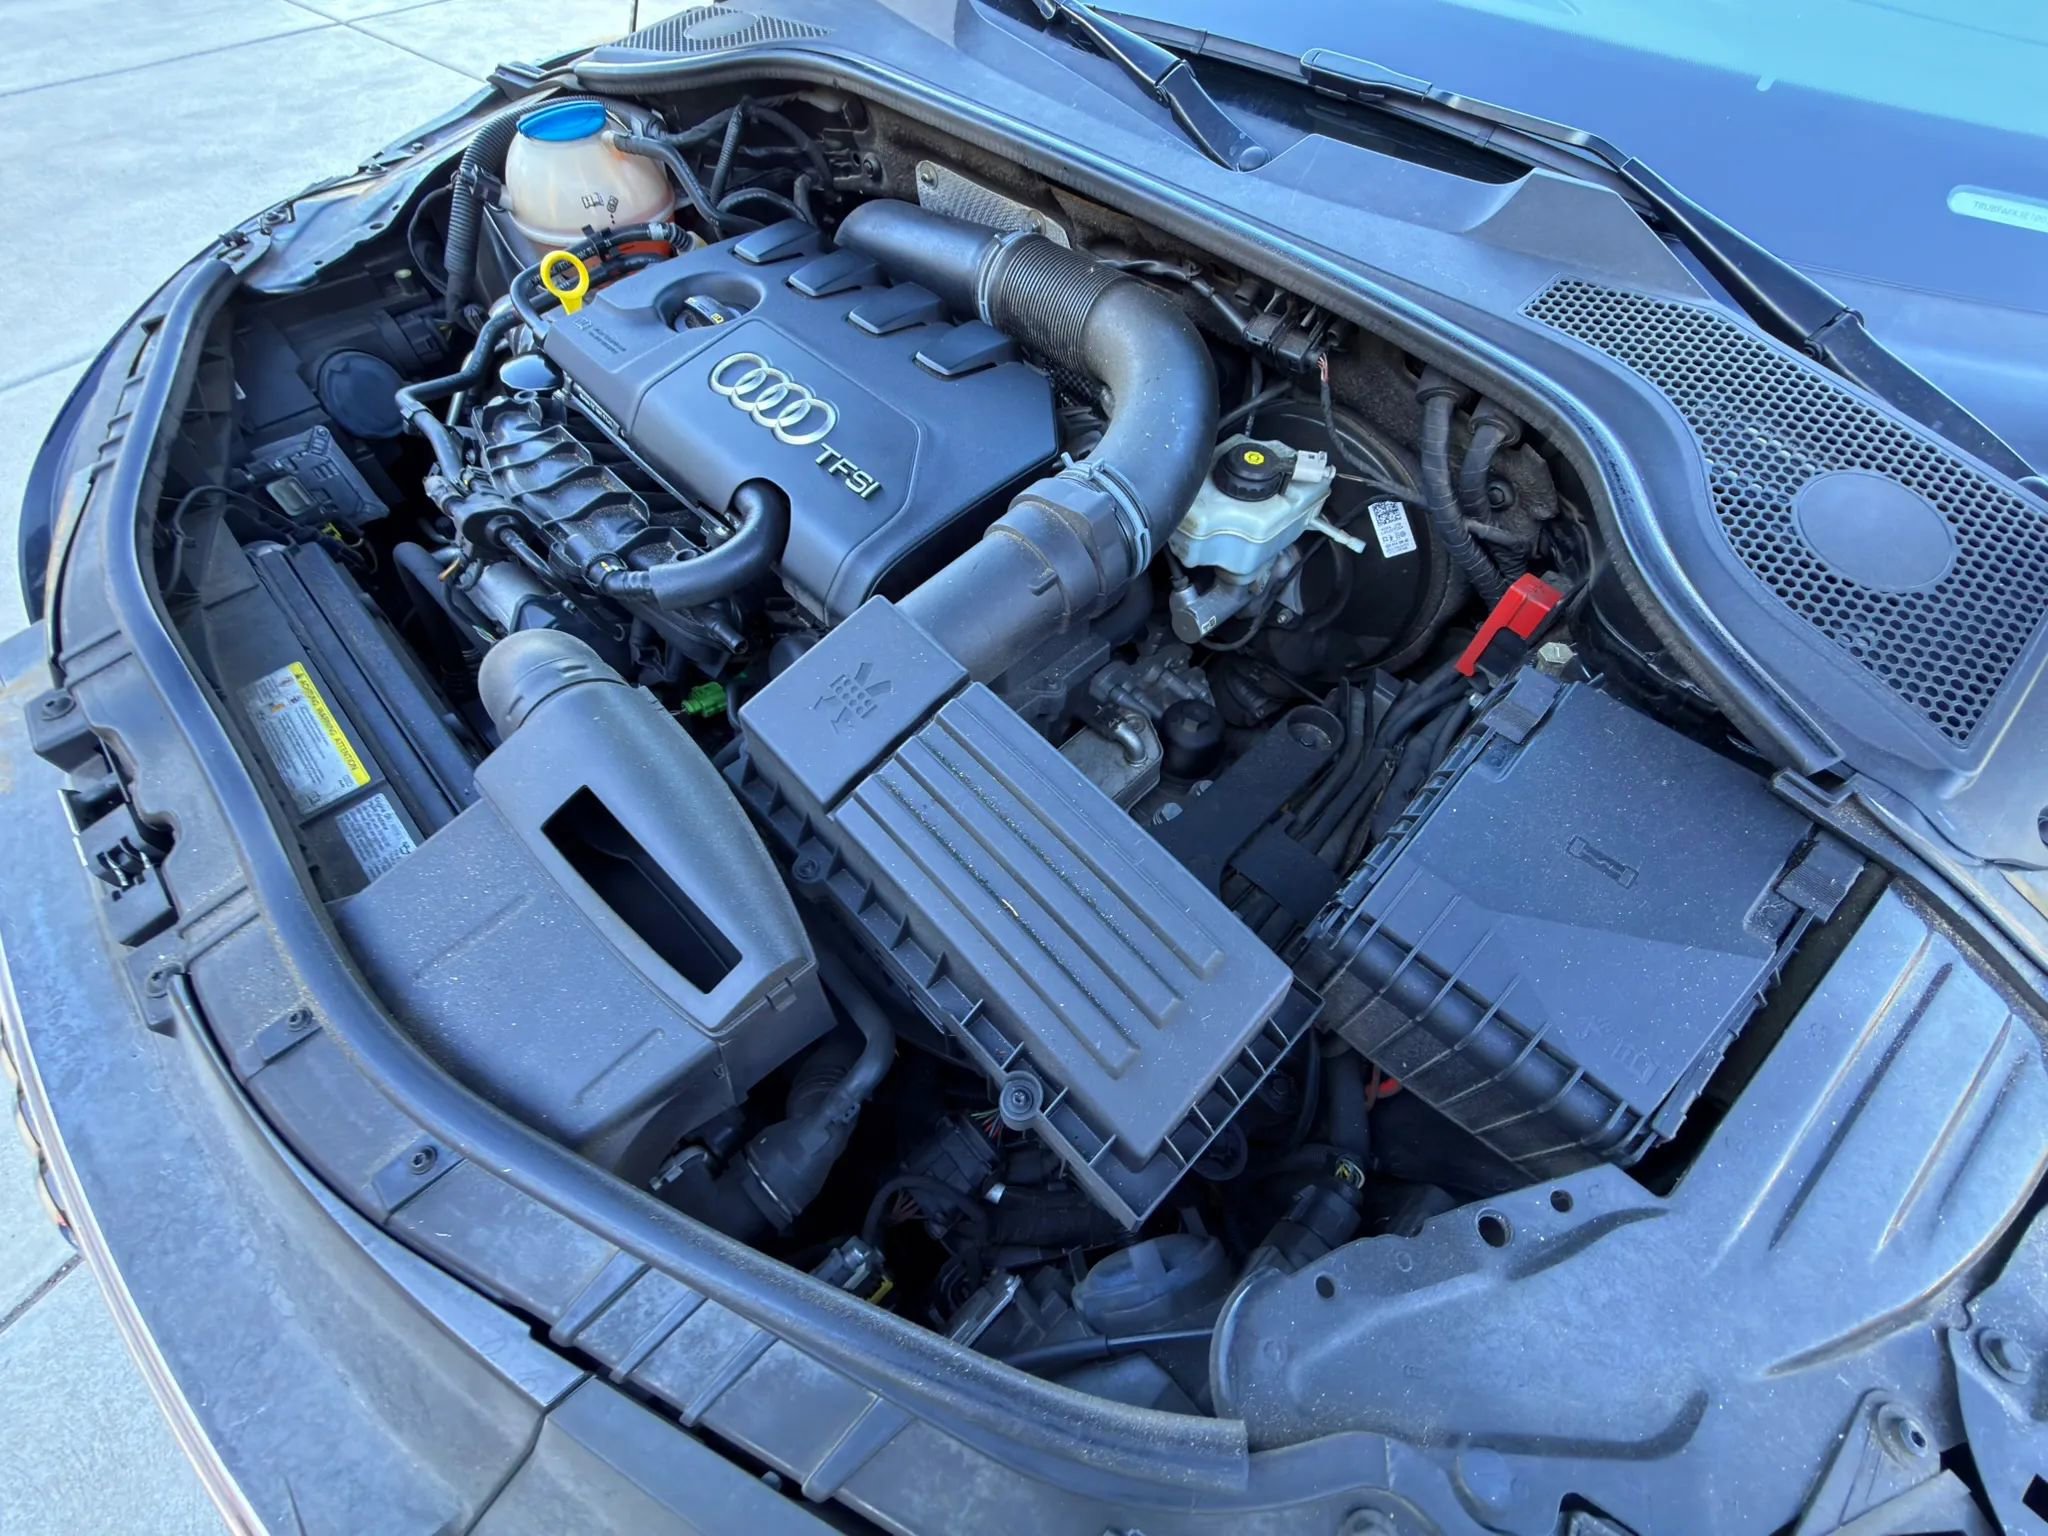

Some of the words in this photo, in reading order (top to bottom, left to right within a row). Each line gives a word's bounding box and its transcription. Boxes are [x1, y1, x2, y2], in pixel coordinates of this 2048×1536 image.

[815, 442, 881, 499] TFSI
[300, 679, 321, 709] ACHTUNG
[316, 706, 338, 737] WARNING
[334, 736, 358, 771] ATTENTION
